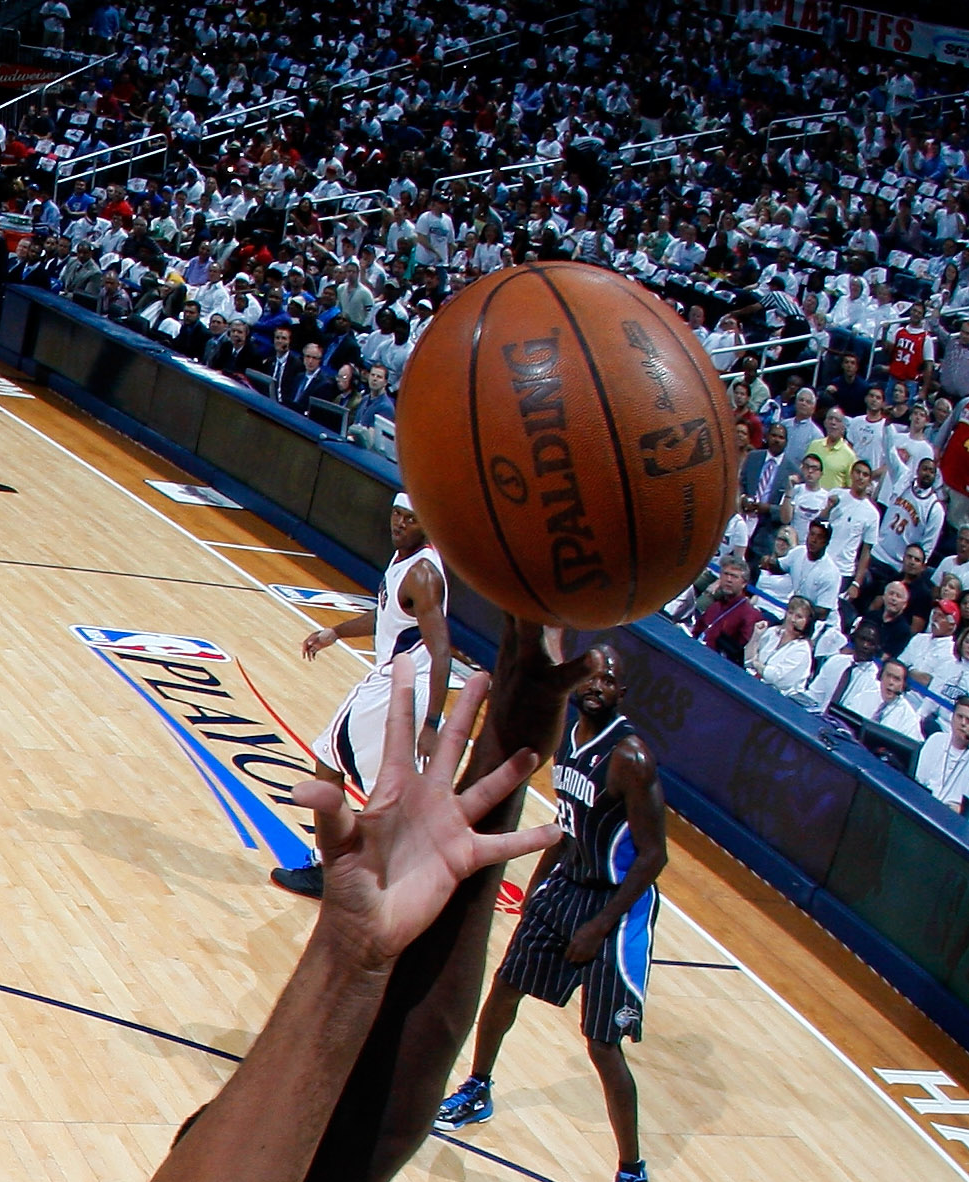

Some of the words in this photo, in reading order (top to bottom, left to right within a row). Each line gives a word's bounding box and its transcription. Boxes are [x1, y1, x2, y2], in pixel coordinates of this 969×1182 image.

[768, 0, 915, 52] PLAOFFS
[895, 350, 911, 366] 34
[896, 337, 916, 355] ATL
[502, 336, 612, 594] SPALDING
[113, 652, 317, 835] PLAYO
